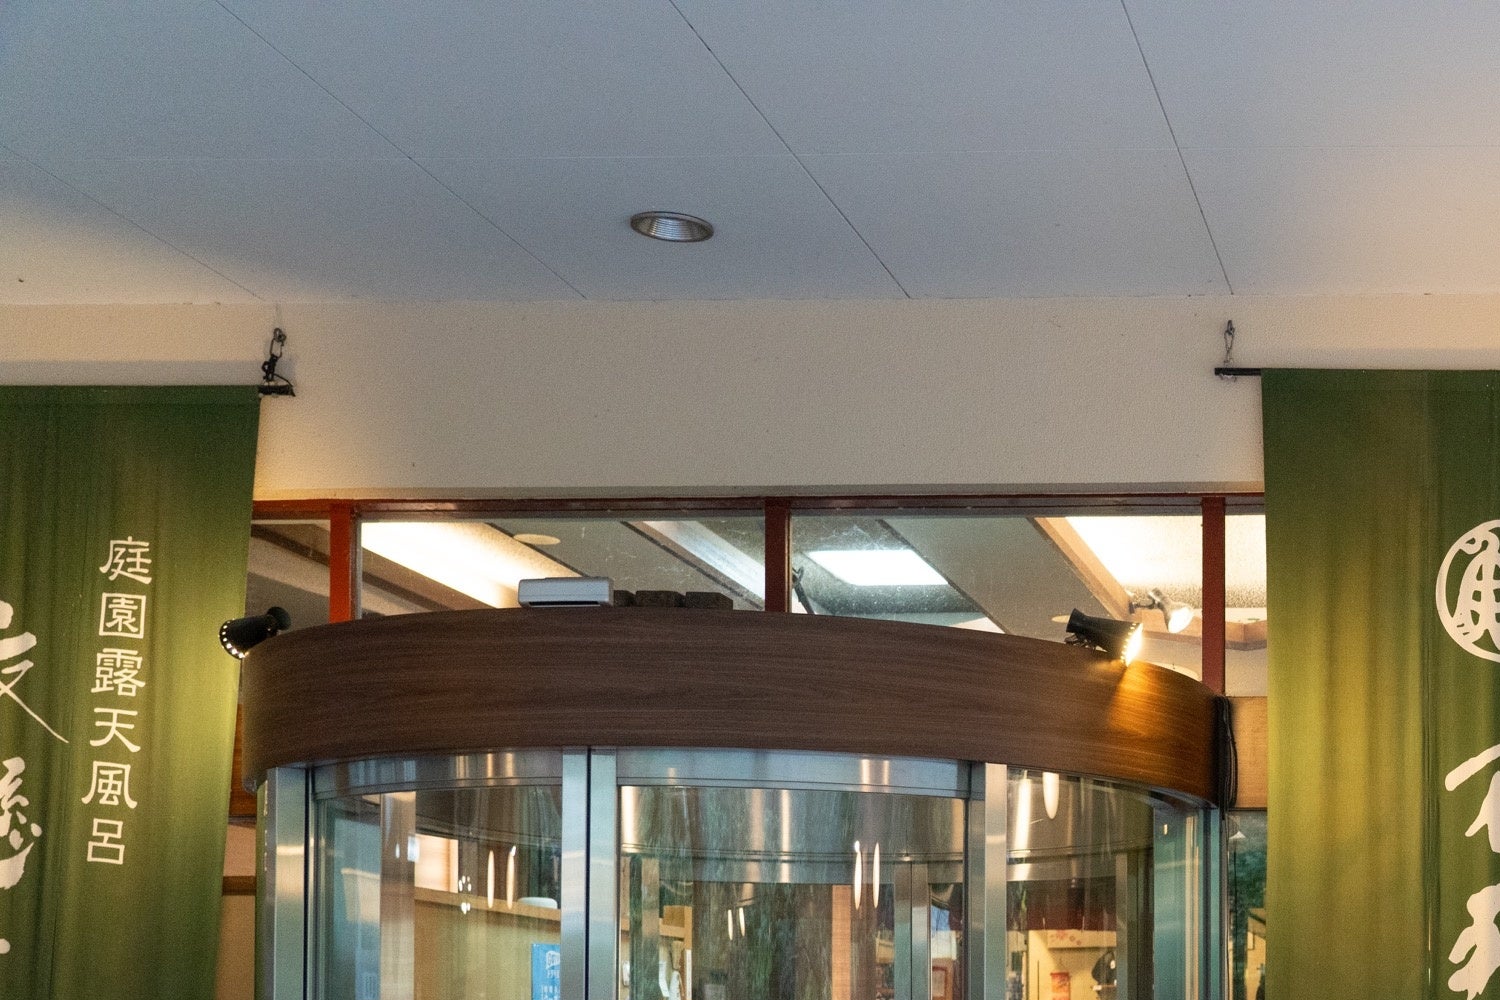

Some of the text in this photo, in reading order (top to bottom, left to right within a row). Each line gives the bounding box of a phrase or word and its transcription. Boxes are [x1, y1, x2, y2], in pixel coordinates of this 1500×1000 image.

[81, 535, 153, 866] 庭園露天風呂
